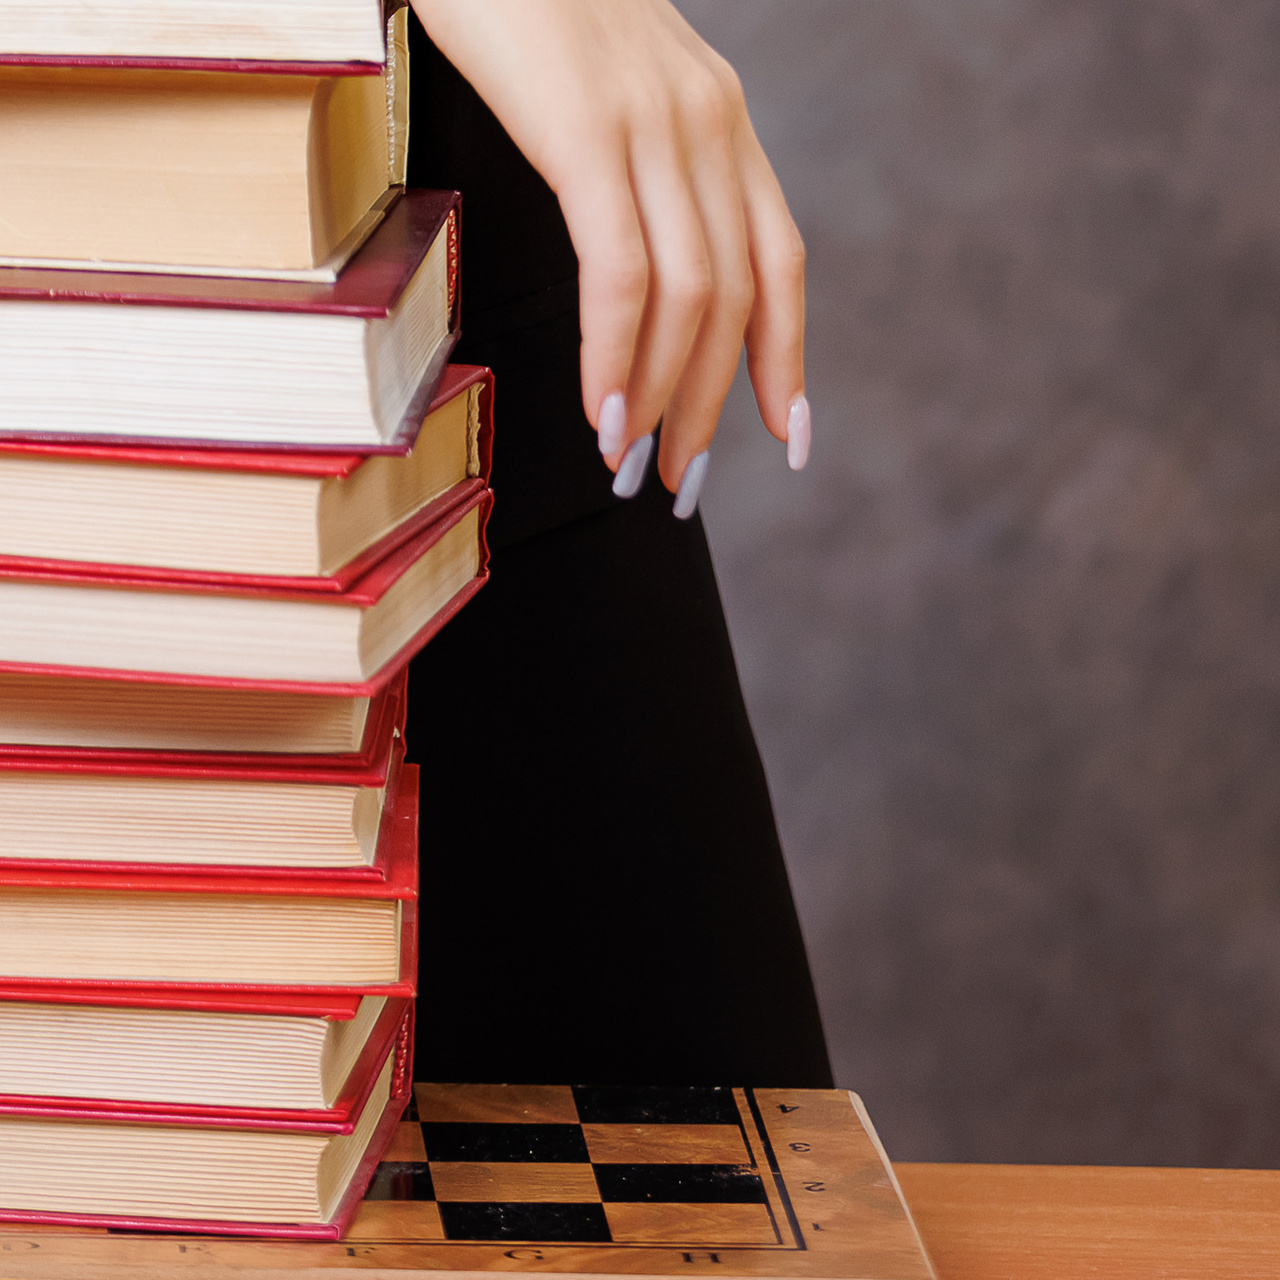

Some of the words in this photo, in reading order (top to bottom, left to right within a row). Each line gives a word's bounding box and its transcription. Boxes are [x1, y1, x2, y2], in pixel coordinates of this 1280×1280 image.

[789, 1143, 811, 1153] 3
[802, 1182, 825, 1192] 2
[345, 1246, 377, 1257] F
[503, 1249, 543, 1260] G
[681, 1252, 721, 1263] H
